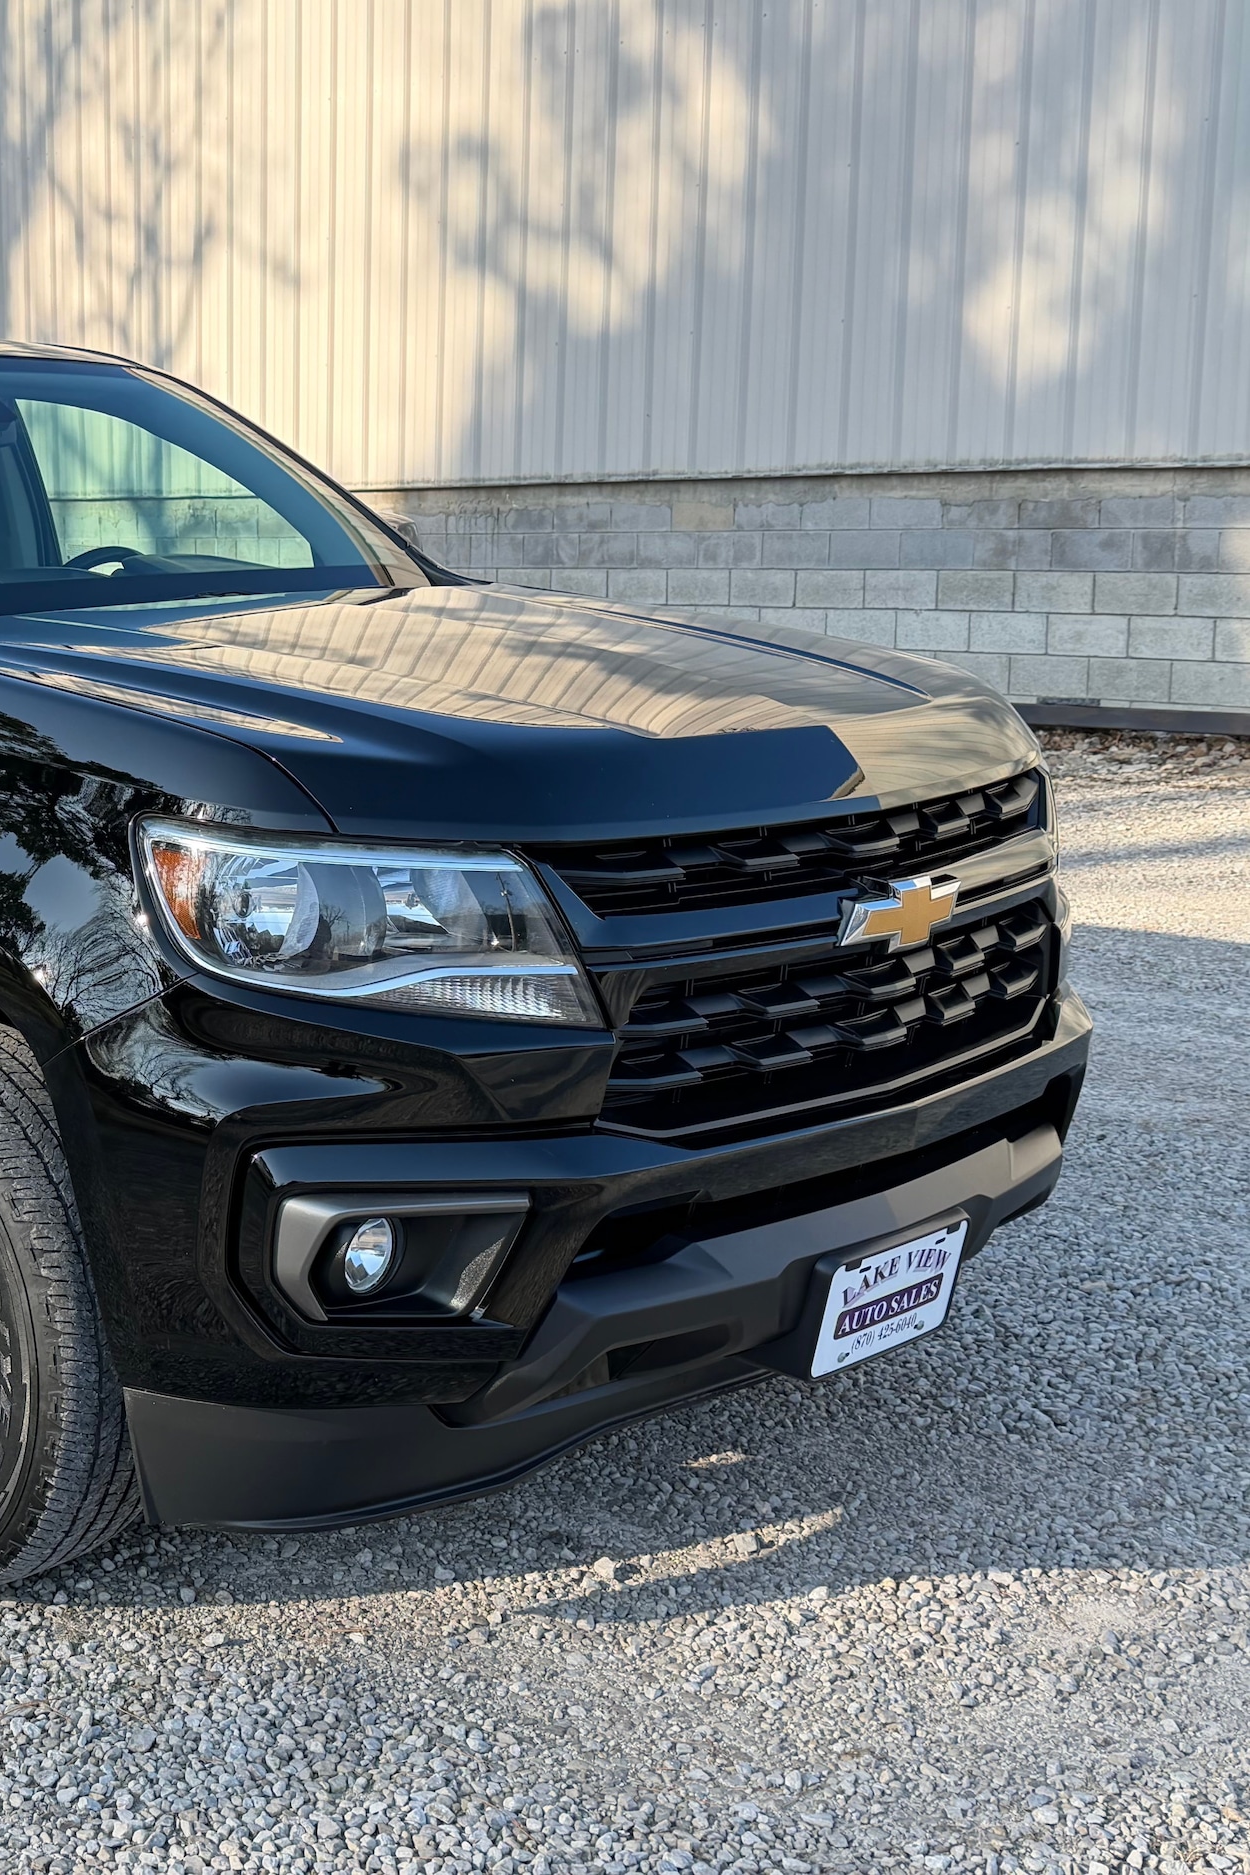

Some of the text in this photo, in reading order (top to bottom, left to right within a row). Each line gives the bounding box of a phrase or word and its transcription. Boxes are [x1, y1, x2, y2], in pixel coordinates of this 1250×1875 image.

[841, 1248, 951, 1308] LAKE VIEW
[838, 1280, 939, 1335] AUTO SALES
[851, 1330, 876, 1353] (870)
